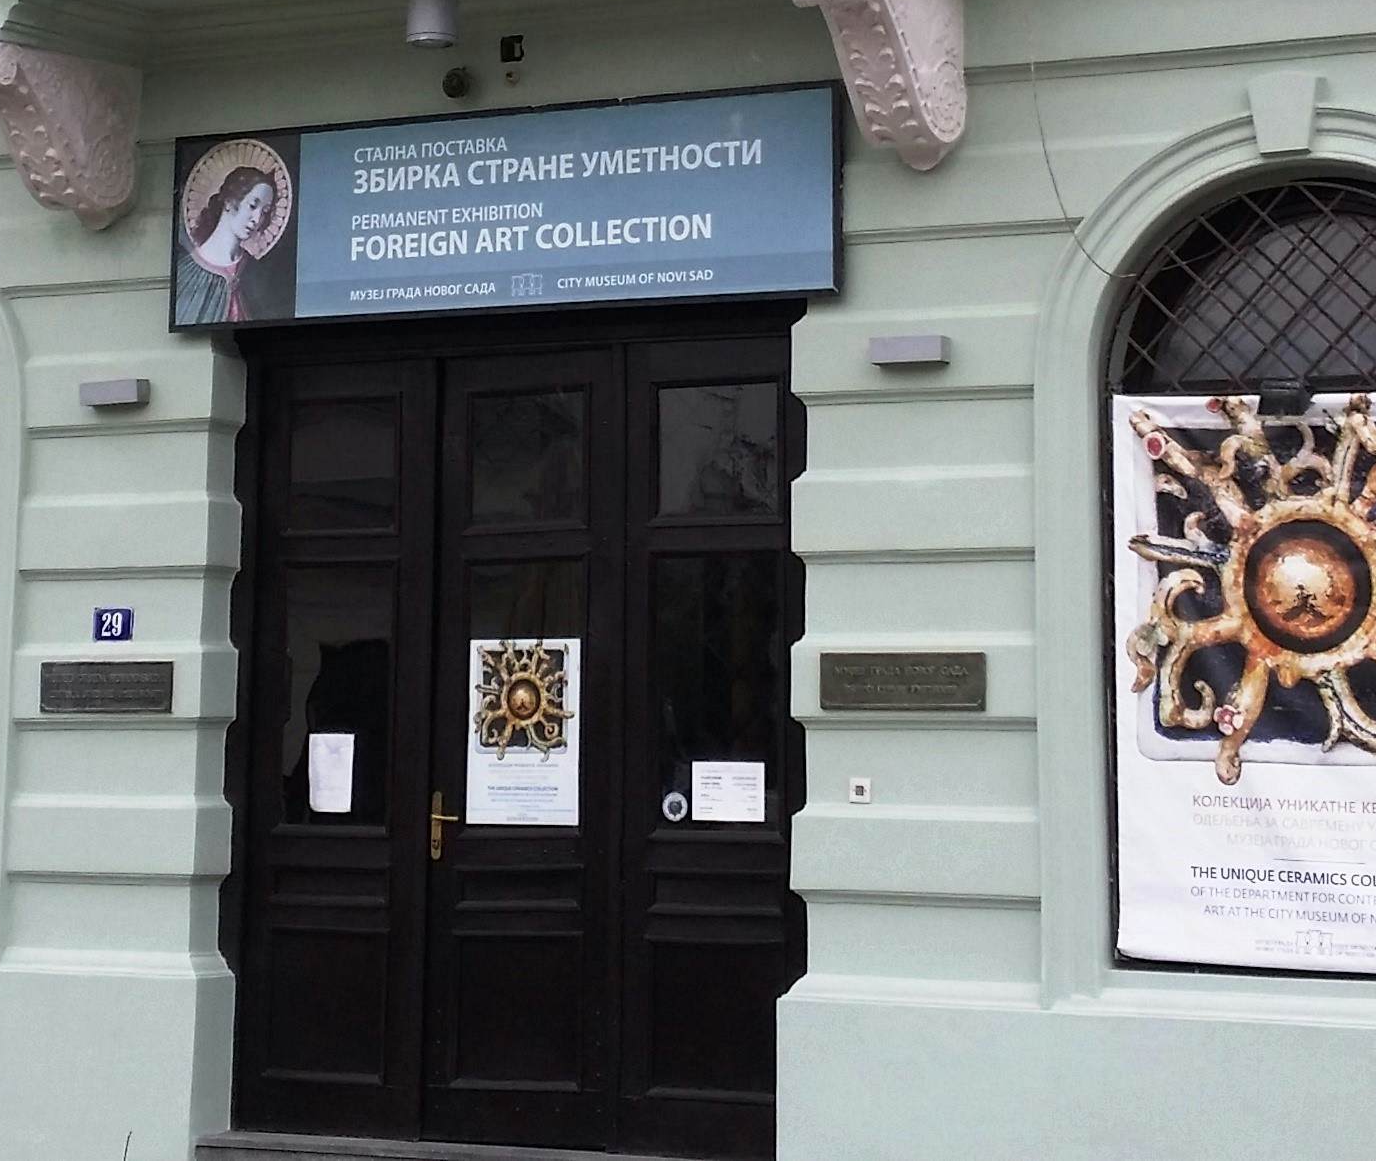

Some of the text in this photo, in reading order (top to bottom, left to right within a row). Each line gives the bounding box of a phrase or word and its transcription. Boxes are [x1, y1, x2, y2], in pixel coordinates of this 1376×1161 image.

[354, 137, 508, 163] СТАЛНА ПОСТАВКА
[353, 139, 761, 194] ЗБИРКА СТРАНЕ УМЕТНОСТИ
[352, 202, 543, 230] PERMANENT EXHIBITION
[351, 213, 712, 261] FOREIGN ART COLLECTION
[557, 269, 713, 289] CITY MUSEUM OF NOVI SAD
[350, 282, 496, 301] МУЗЕЈ ГРАДА НОВОГ САДА
[101, 612, 123, 637] 29
[1192, 795, 1272, 811] КОЛЕКЦИЈА
[1278, 799, 1357, 813] УНИКАТНЕ
[1191, 866, 1217, 879] THE
[1220, 867, 1275, 884] UNIQUE
[1278, 870, 1347, 886] CERAMICS
[1191, 886, 1205, 897] OF
[1209, 887, 1229, 898] THE
[1233, 888, 1309, 903] DEPARTMENT
[1312, 892, 1335, 904] FOR
[1204, 905, 1225, 916] ART
[1227, 906, 1241, 917] AT
[1245, 907, 1265, 918] THE
[1268, 908, 1293, 920] CITY
[1296, 910, 1349, 923] MUSEUM
[1351, 913, 1367, 923] OF
